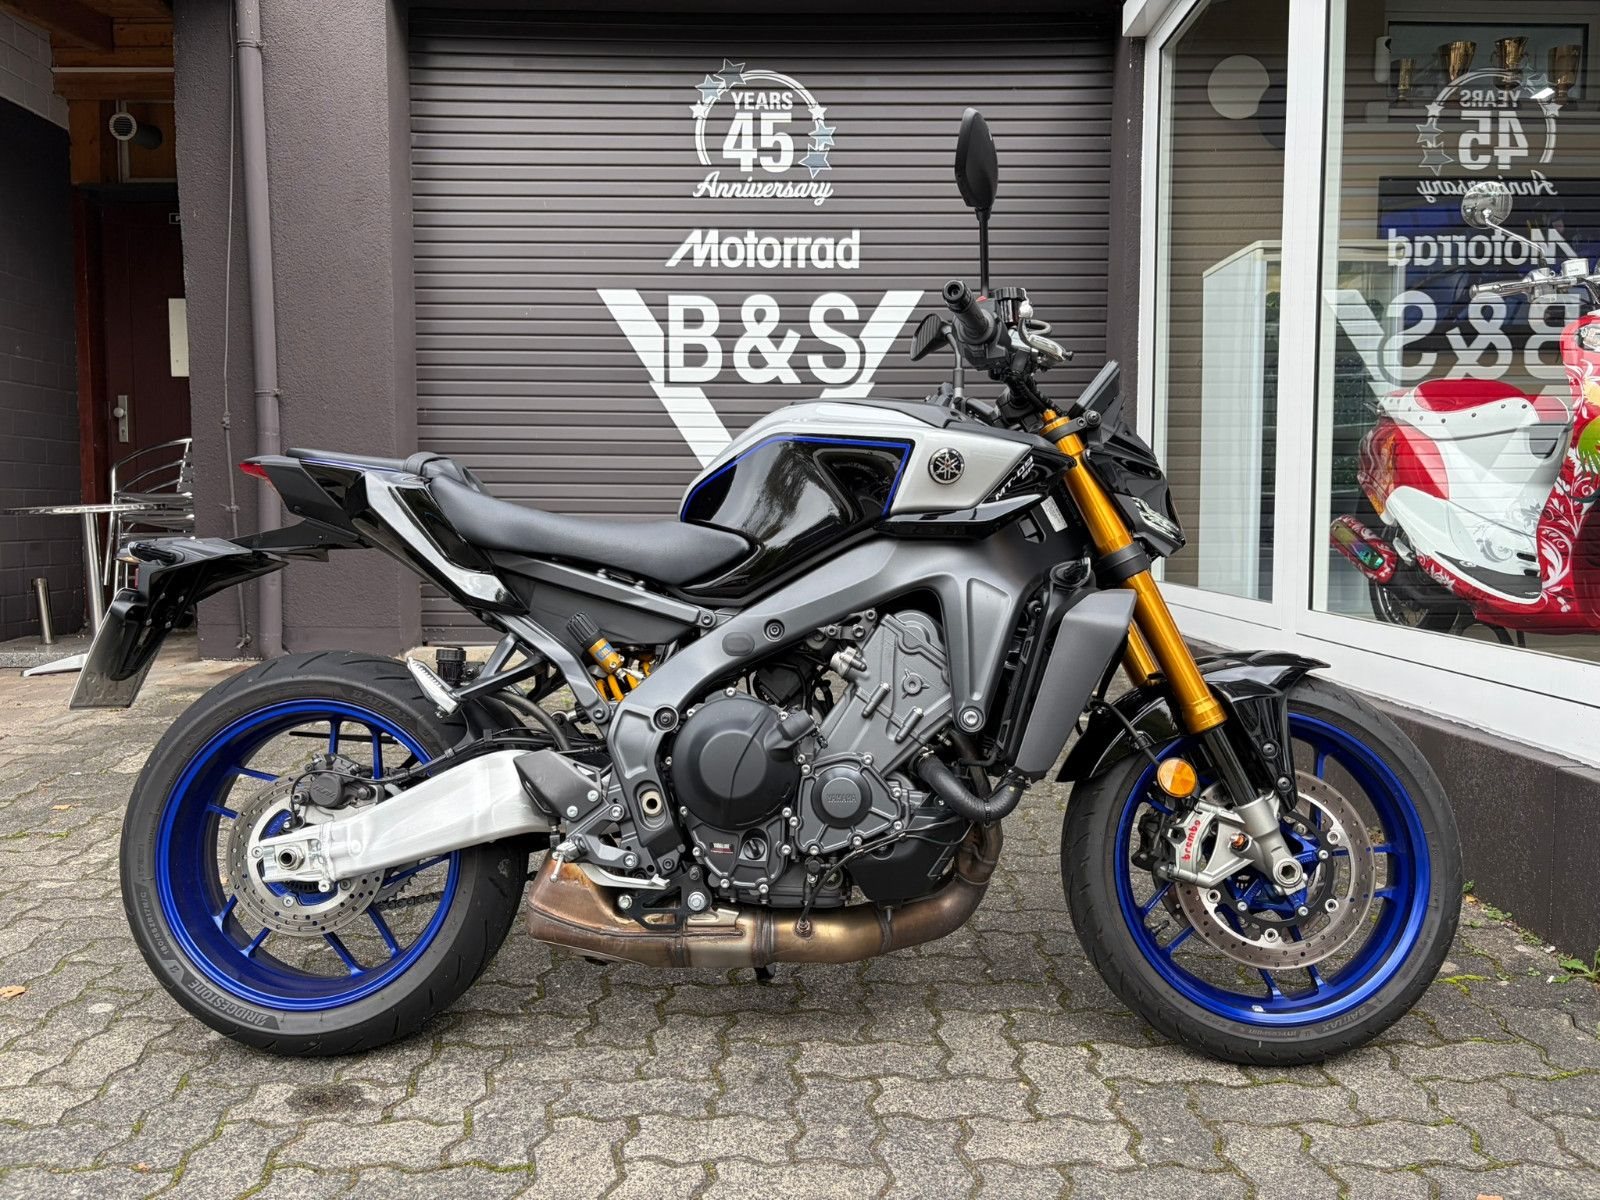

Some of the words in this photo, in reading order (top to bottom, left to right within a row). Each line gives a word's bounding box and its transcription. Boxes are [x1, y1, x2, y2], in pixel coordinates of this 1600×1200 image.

[730, 92, 794, 111] YEARS
[722, 111, 795, 174] 45
[692, 171, 834, 206] Anniversary
[665, 229, 861, 269] Motorrad
[667, 292, 864, 384] B&S
[995, 455, 1034, 501] MT-09
[1181, 819, 1201, 861] brembo
[187, 978, 270, 1027] BRIDGESTONE
